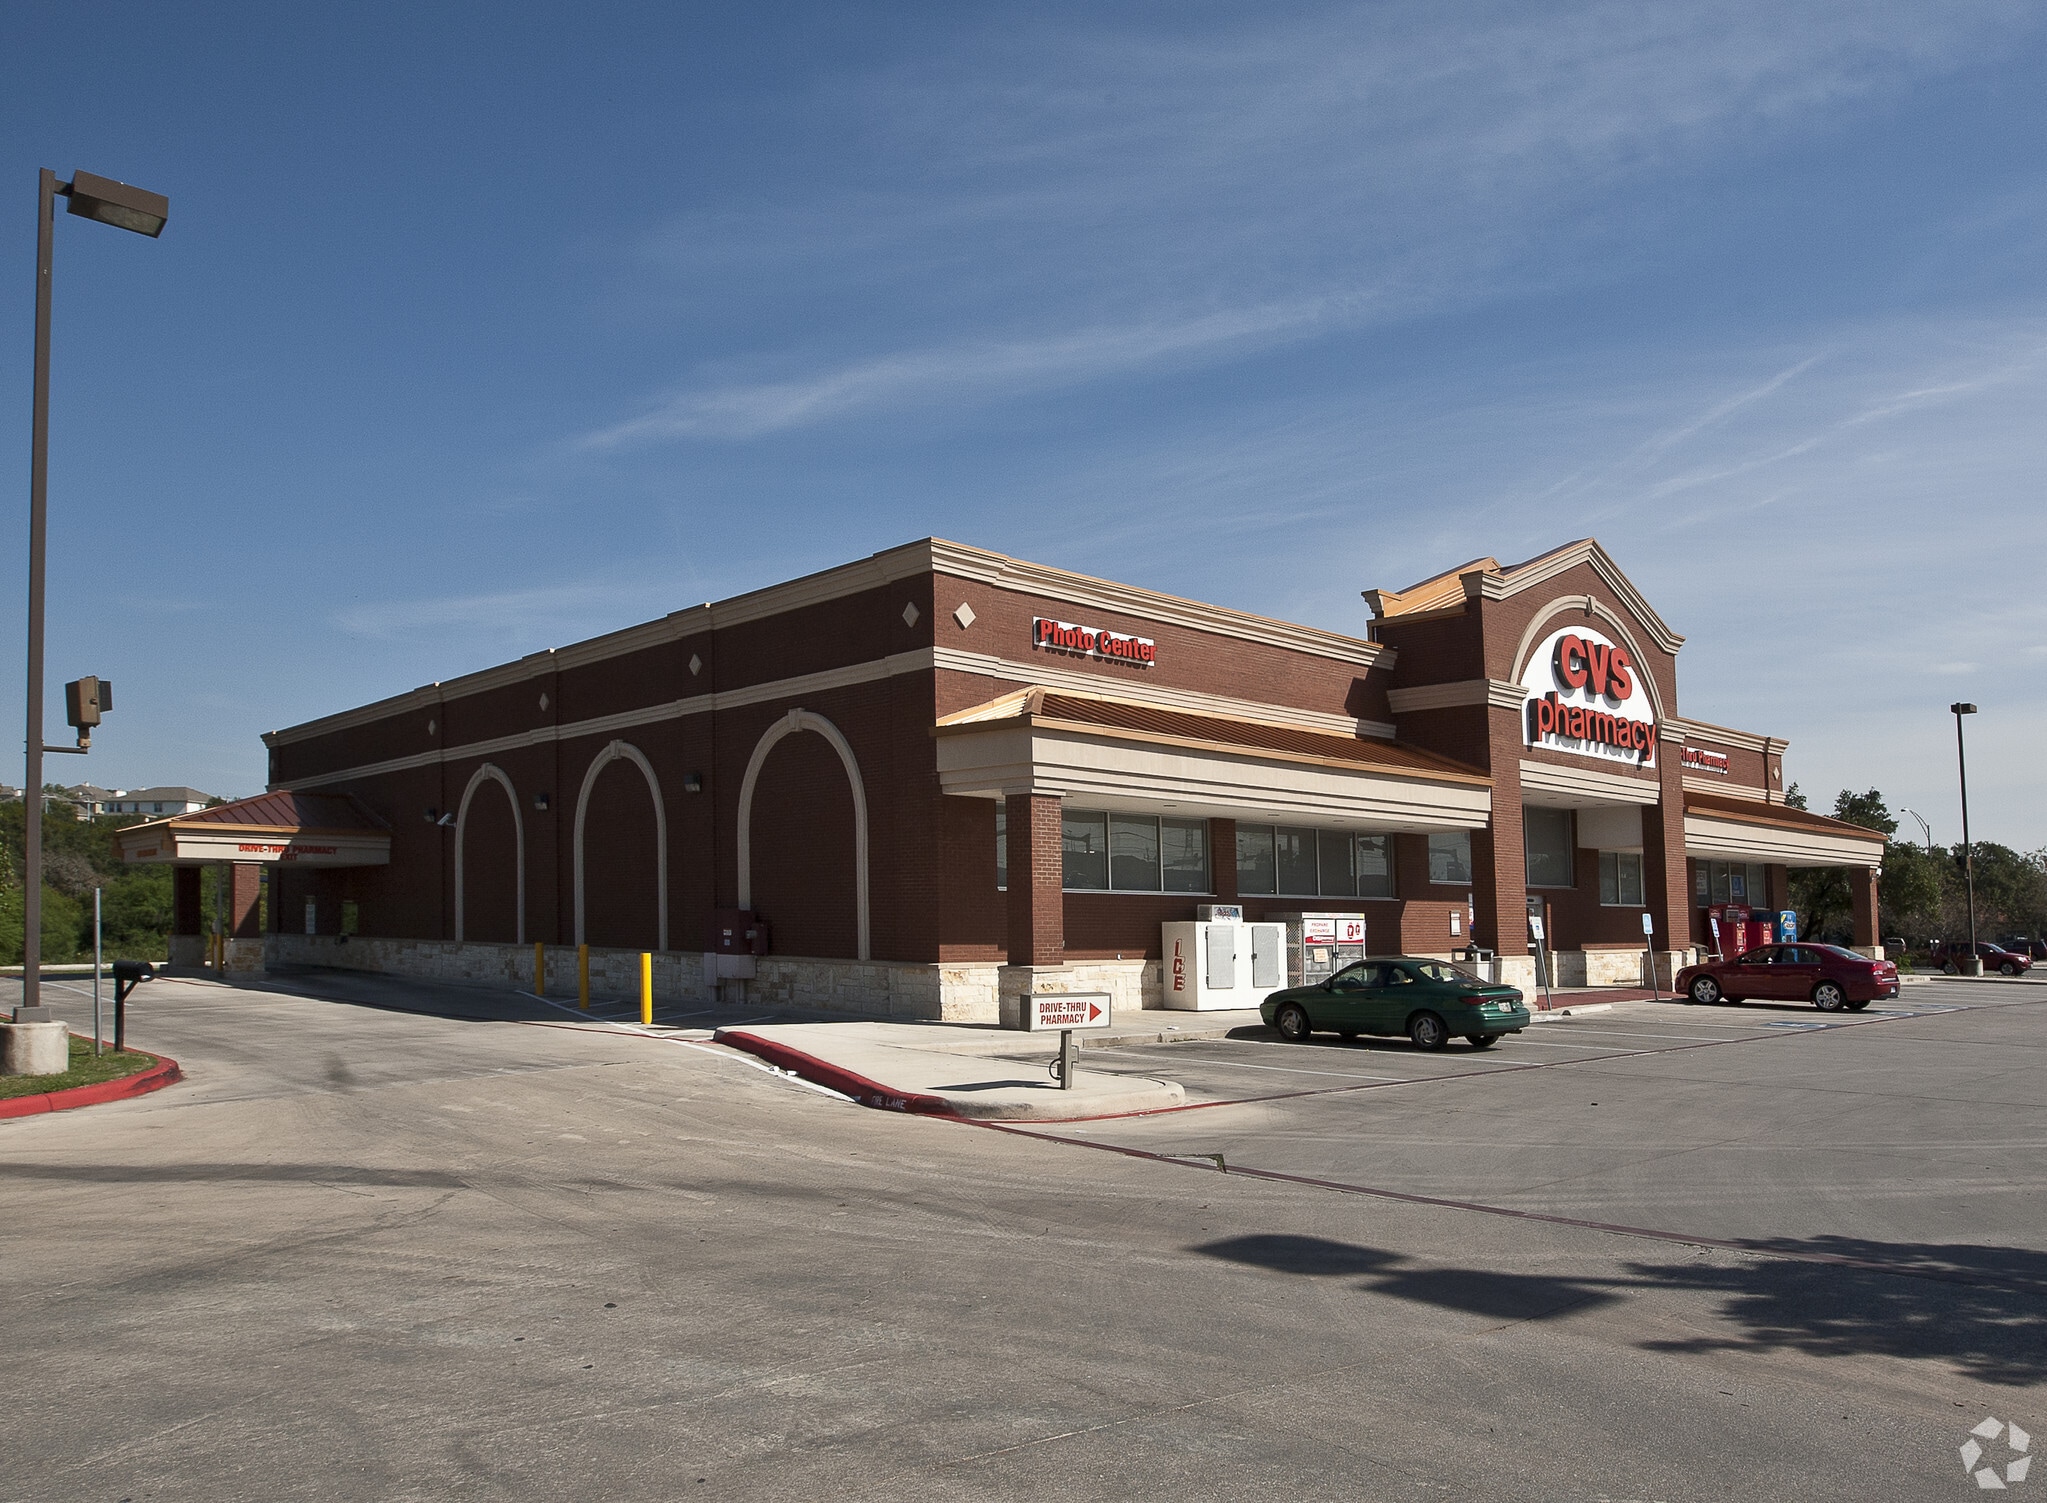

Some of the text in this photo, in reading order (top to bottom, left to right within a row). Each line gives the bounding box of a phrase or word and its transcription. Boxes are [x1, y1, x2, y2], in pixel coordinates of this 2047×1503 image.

[1040, 619, 1157, 661] Photo Center
[1561, 634, 1633, 700] CVS
[1537, 691, 1657, 762] pharmacy
[238, 844, 338, 855] DRIVE-THRU PHARMACY
[1173, 938, 1186, 991] ICE
[1039, 1001, 1087, 1013] DRIVE-THRU
[1040, 1013, 1085, 1025] PHARMACY
